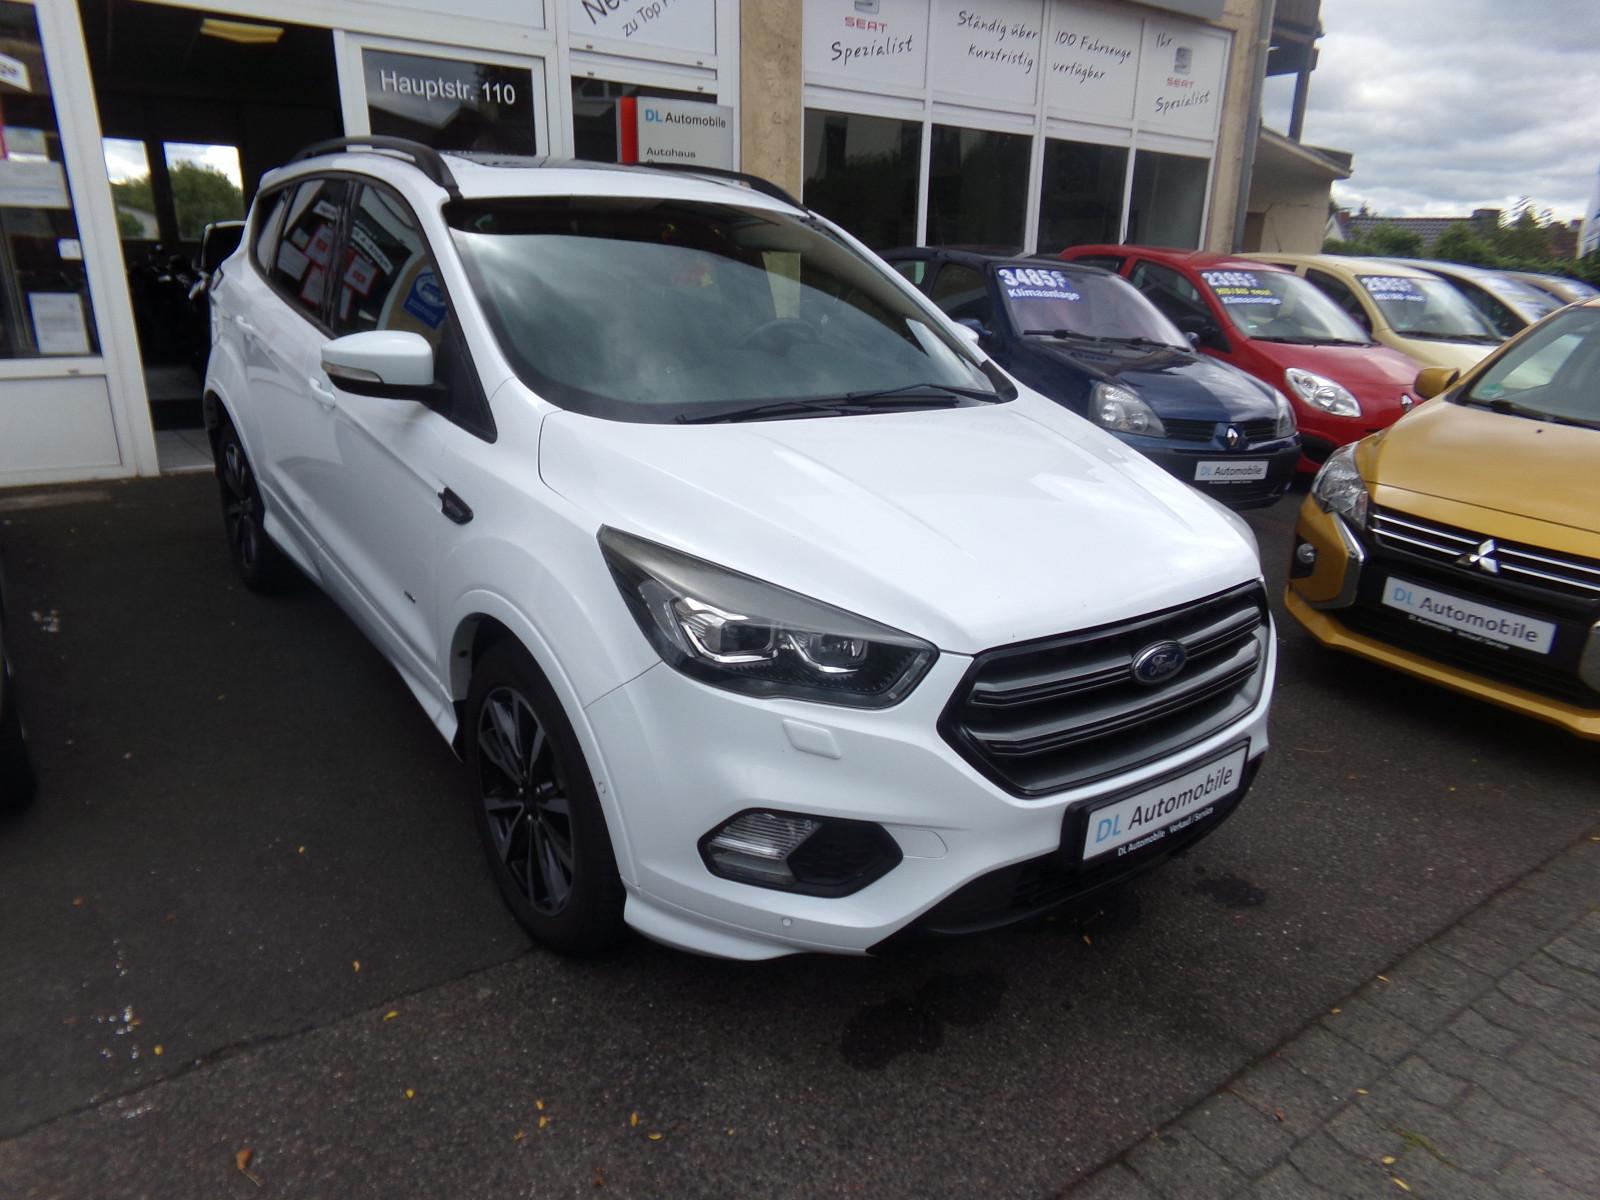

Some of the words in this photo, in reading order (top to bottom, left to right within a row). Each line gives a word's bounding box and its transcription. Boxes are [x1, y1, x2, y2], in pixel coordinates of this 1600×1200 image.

[622, 19, 638, 37] zu
[636, 3, 662, 24] Top
[844, 16, 887, 32] SEAT
[957, 10, 1007, 42] Ständig
[1011, 23, 1038, 39] über
[831, 34, 913, 66] Spezialist
[1055, 31, 1077, 46] 100
[1080, 35, 1132, 64] Fahrzeuge
[1156, 32, 1173, 48] Ihr
[1053, 62, 1106, 84] verfügbar
[1167, 77, 1195, 88] SEAT
[380, 69, 474, 101] Hauptstr.
[481, 81, 516, 105] 110
[1155, 90, 1210, 115] Spezialist
[644, 109, 663, 123] DL
[664, 111, 727, 129] Automobile
[646, 147, 696, 159] Autohaus
[1007, 288, 1081, 301] Klimaanlage
[1214, 465, 1264, 476] Automobile
[1392, 586, 1414, 606] DL
[1419, 596, 1540, 643] Automobile
[1095, 813, 1121, 844] DL
[1127, 765, 1233, 831] Automobile
